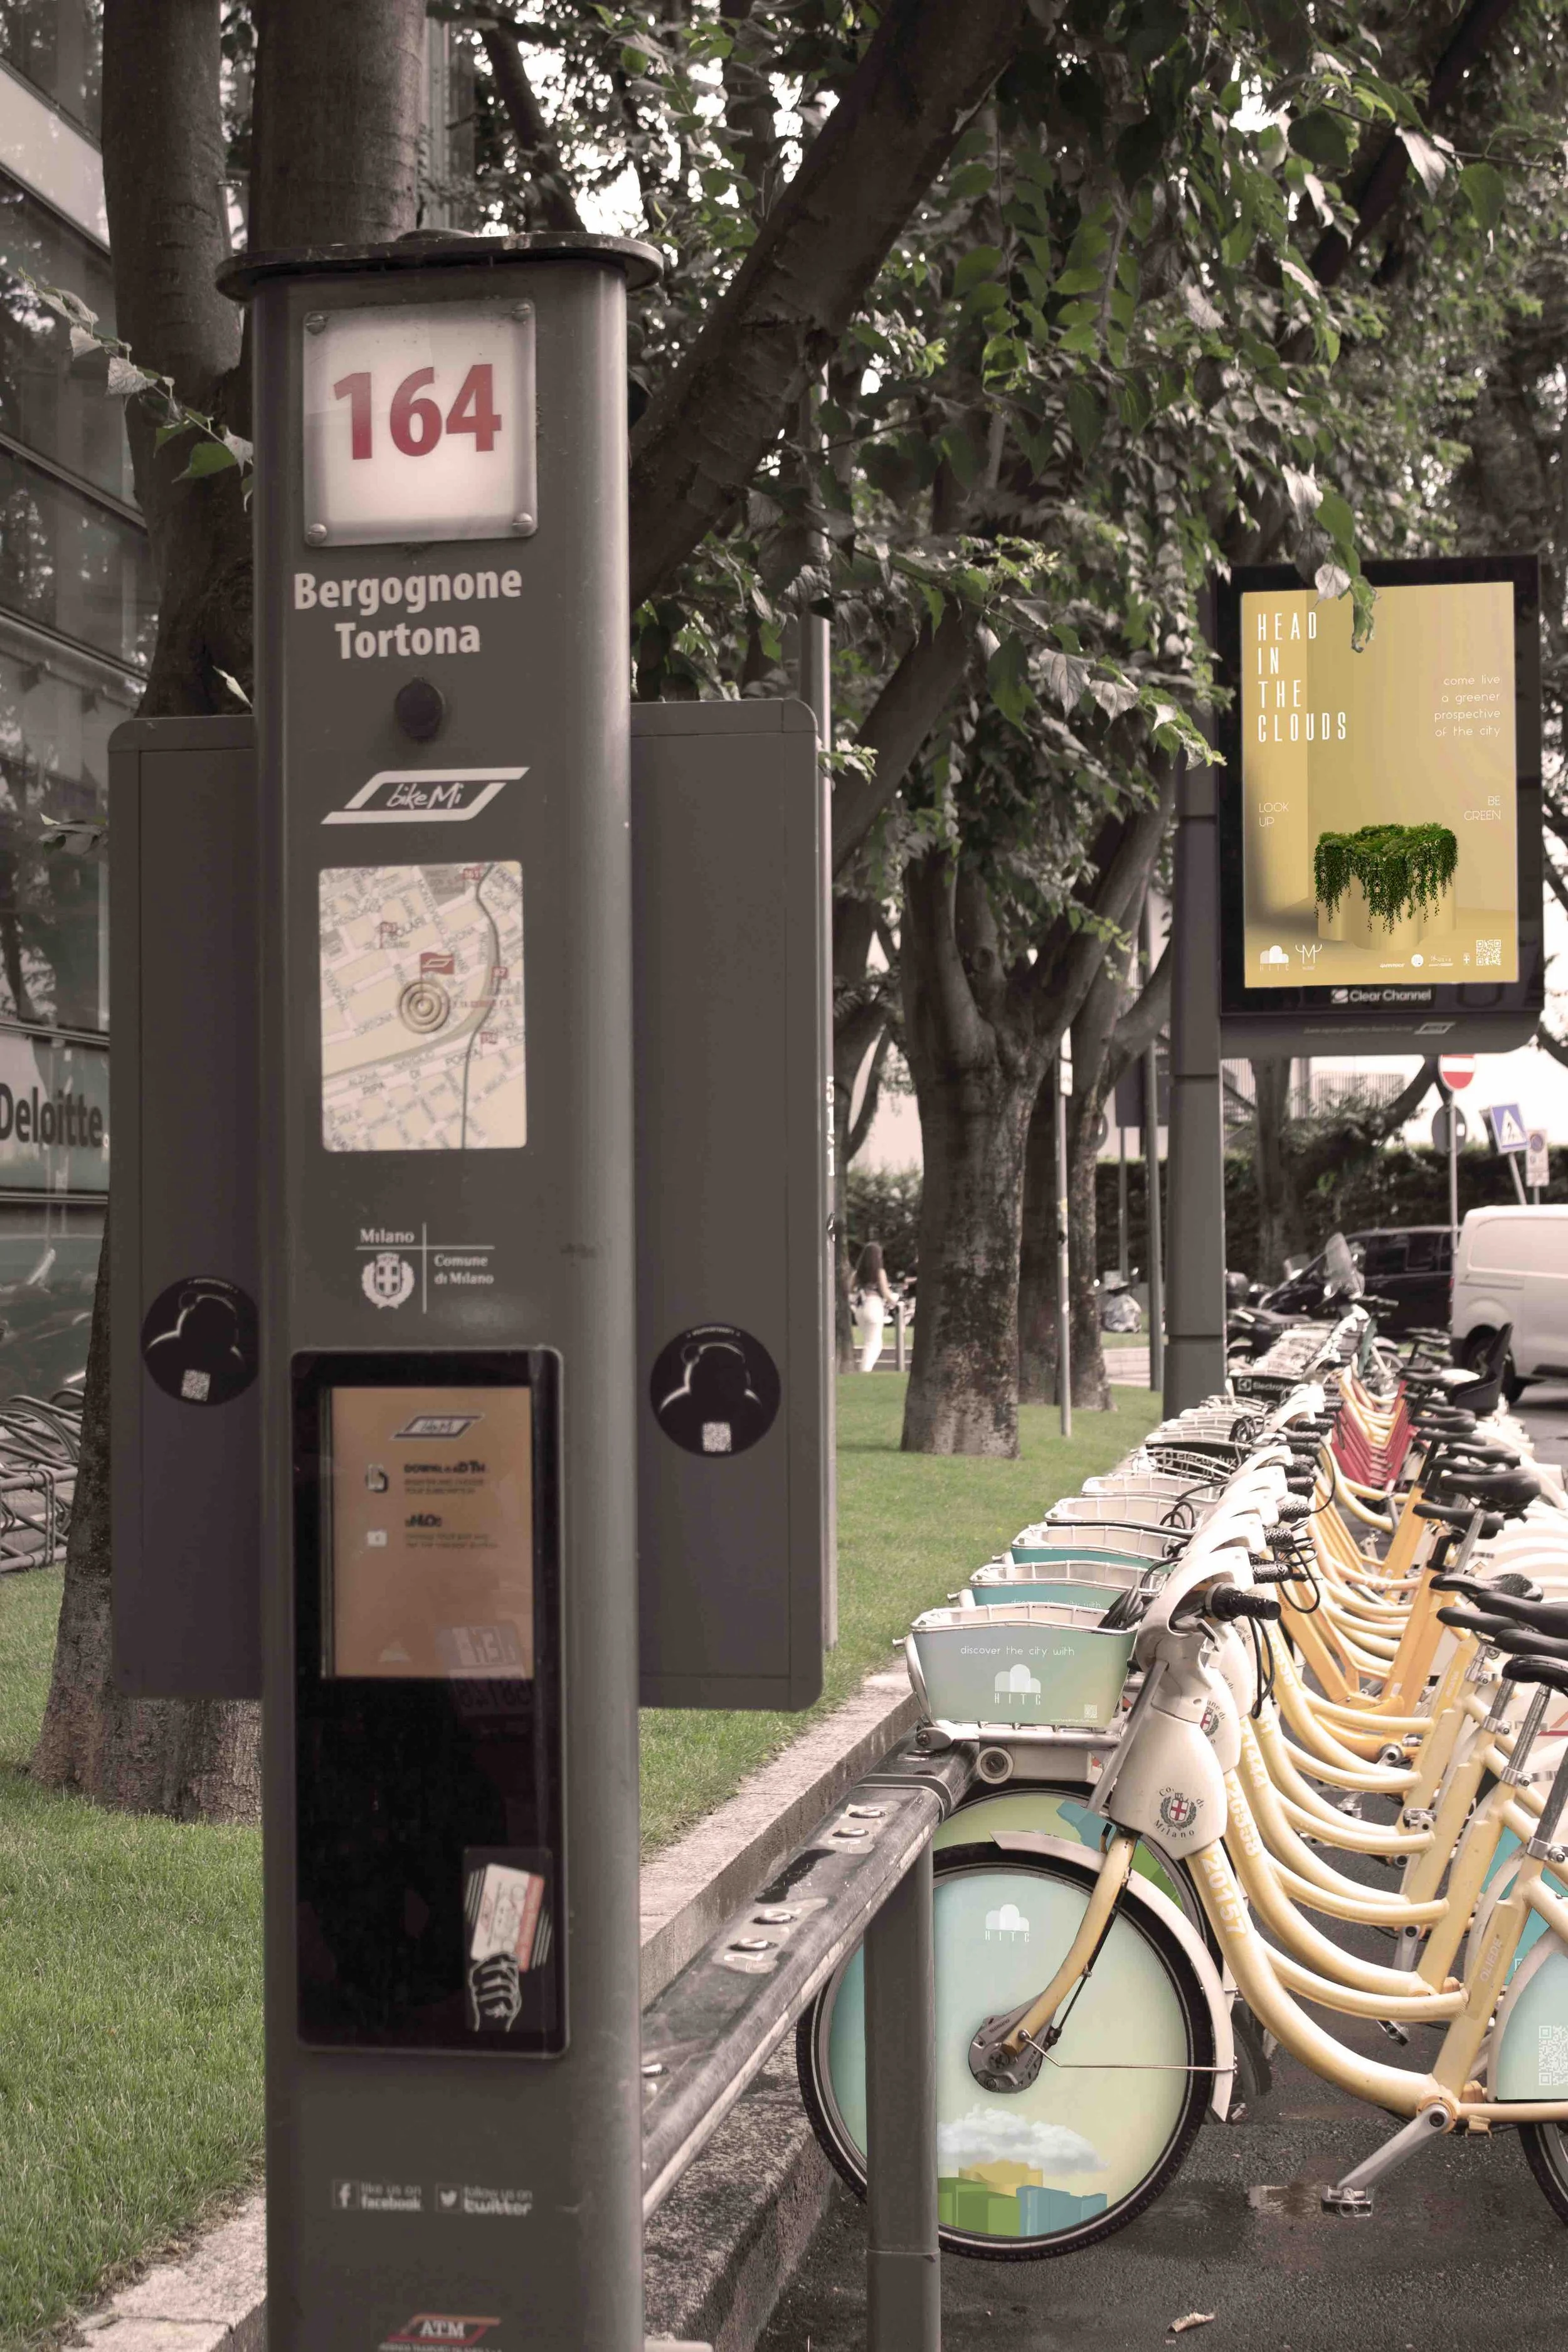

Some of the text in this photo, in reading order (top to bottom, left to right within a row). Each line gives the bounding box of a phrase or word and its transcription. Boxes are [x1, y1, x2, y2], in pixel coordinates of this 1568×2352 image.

[334, 363, 502, 460] 164
[294, 569, 522, 617] Bergognone
[1258, 612, 1316, 641] HEAD
[334, 623, 480, 659] Tortona
[1258, 647, 1279, 675] IN
[1444, 674, 1500, 686] come live
[1258, 680, 1301, 708] THE
[1455, 693, 1500, 705] greener
[1434, 708, 1500, 723] prospective
[1258, 712, 1347, 743] CLOUDS
[1435, 725, 1501, 738] of the city
[1259, 802, 1290, 813] LOOK
[1488, 795, 1501, 806] BE
[1259, 817, 1274, 827] UP
[1464, 810, 1502, 821] GREEN
[1350, 988, 1432, 1002] Clear Channel
[0, 1082, 103, 1148] Deloitte
[360, 1227, 415, 1244] Milano
[434, 1254, 489, 1268] Comune
[434, 1272, 494, 1285] di Milano
[960, 1646, 1074, 1658] discover the city with
[994, 1693, 1041, 1705] HITC
[1155, 1819, 1195, 1838] Milano
[1200, 1852, 1247, 1936] 20157
[361, 2195, 422, 2211] facebook
[463, 2198, 532, 2217] twitter
[419, 2319, 467, 2340] ATM
